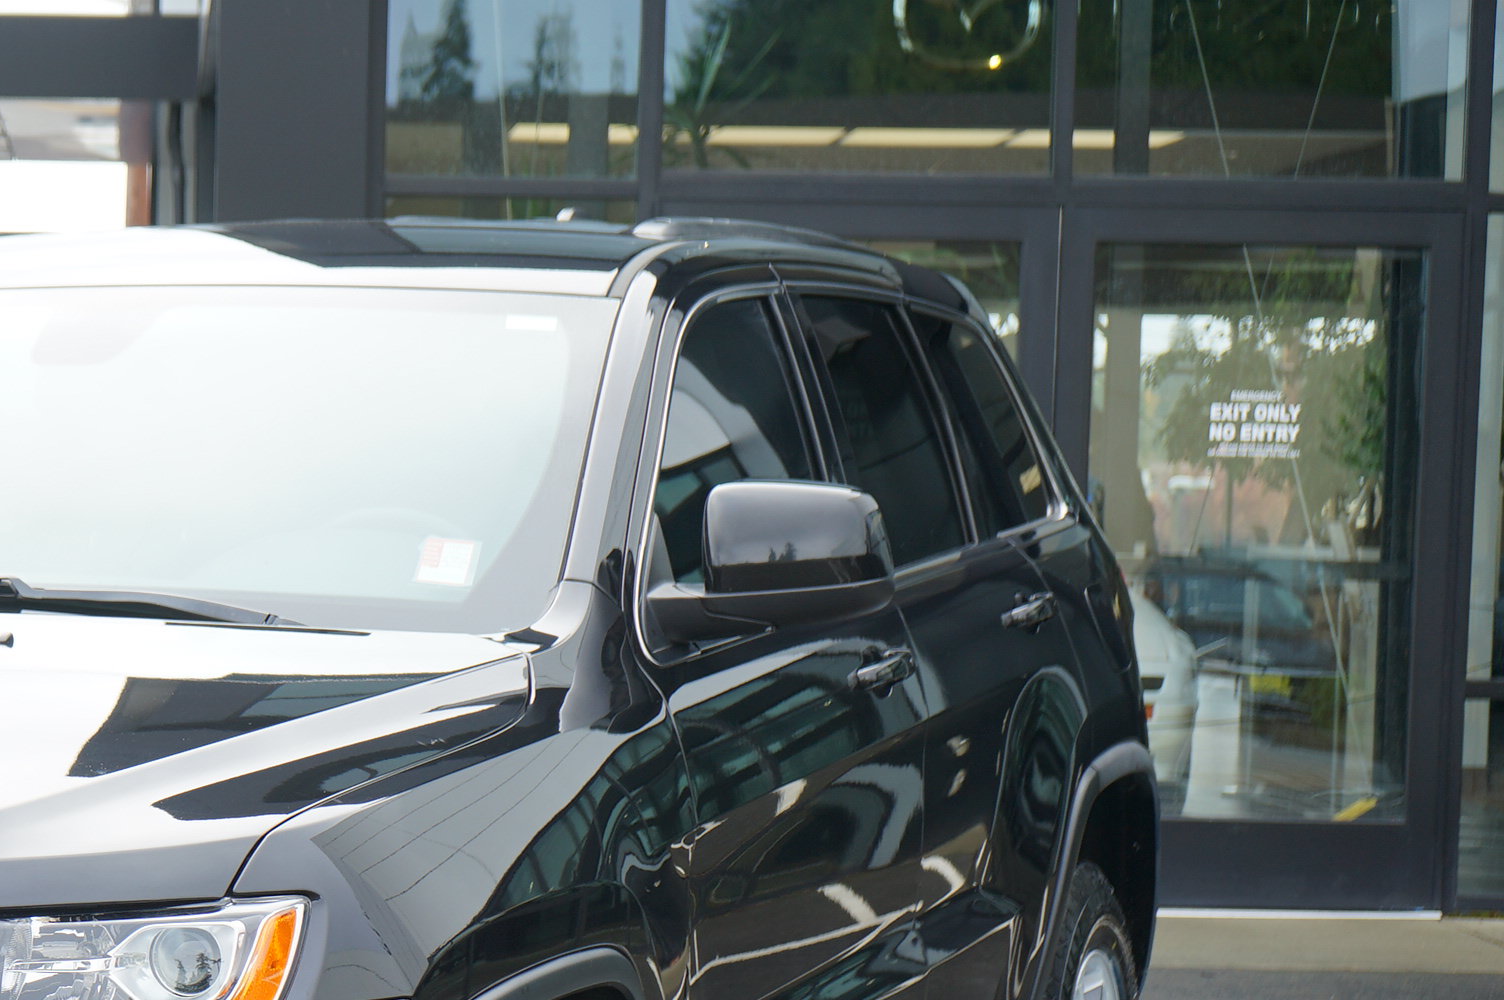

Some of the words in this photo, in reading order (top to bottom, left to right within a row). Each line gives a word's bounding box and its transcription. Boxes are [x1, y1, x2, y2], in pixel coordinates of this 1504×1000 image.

[1210, 402, 1251, 421] EXIT
[1254, 403, 1301, 423] ONLY
[1209, 422, 1236, 441] NO
[1240, 423, 1300, 443] ENTRY
